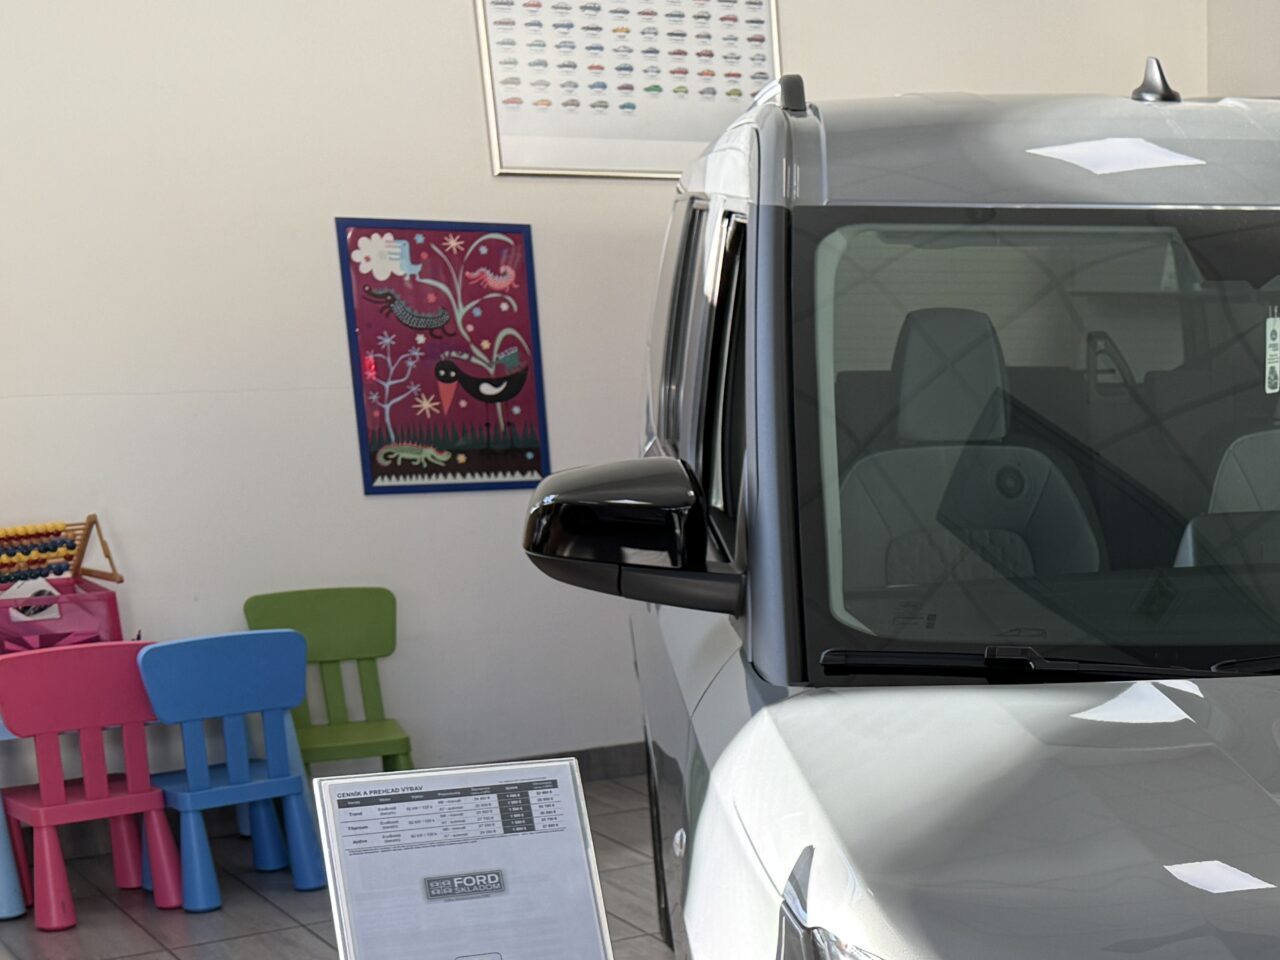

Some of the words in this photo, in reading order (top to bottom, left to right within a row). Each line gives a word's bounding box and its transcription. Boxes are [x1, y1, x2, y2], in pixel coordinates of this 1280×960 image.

[337, 790, 362, 799] CENNÍK
[453, 873, 499, 887] FORD
[454, 882, 501, 894] SKLADOM
